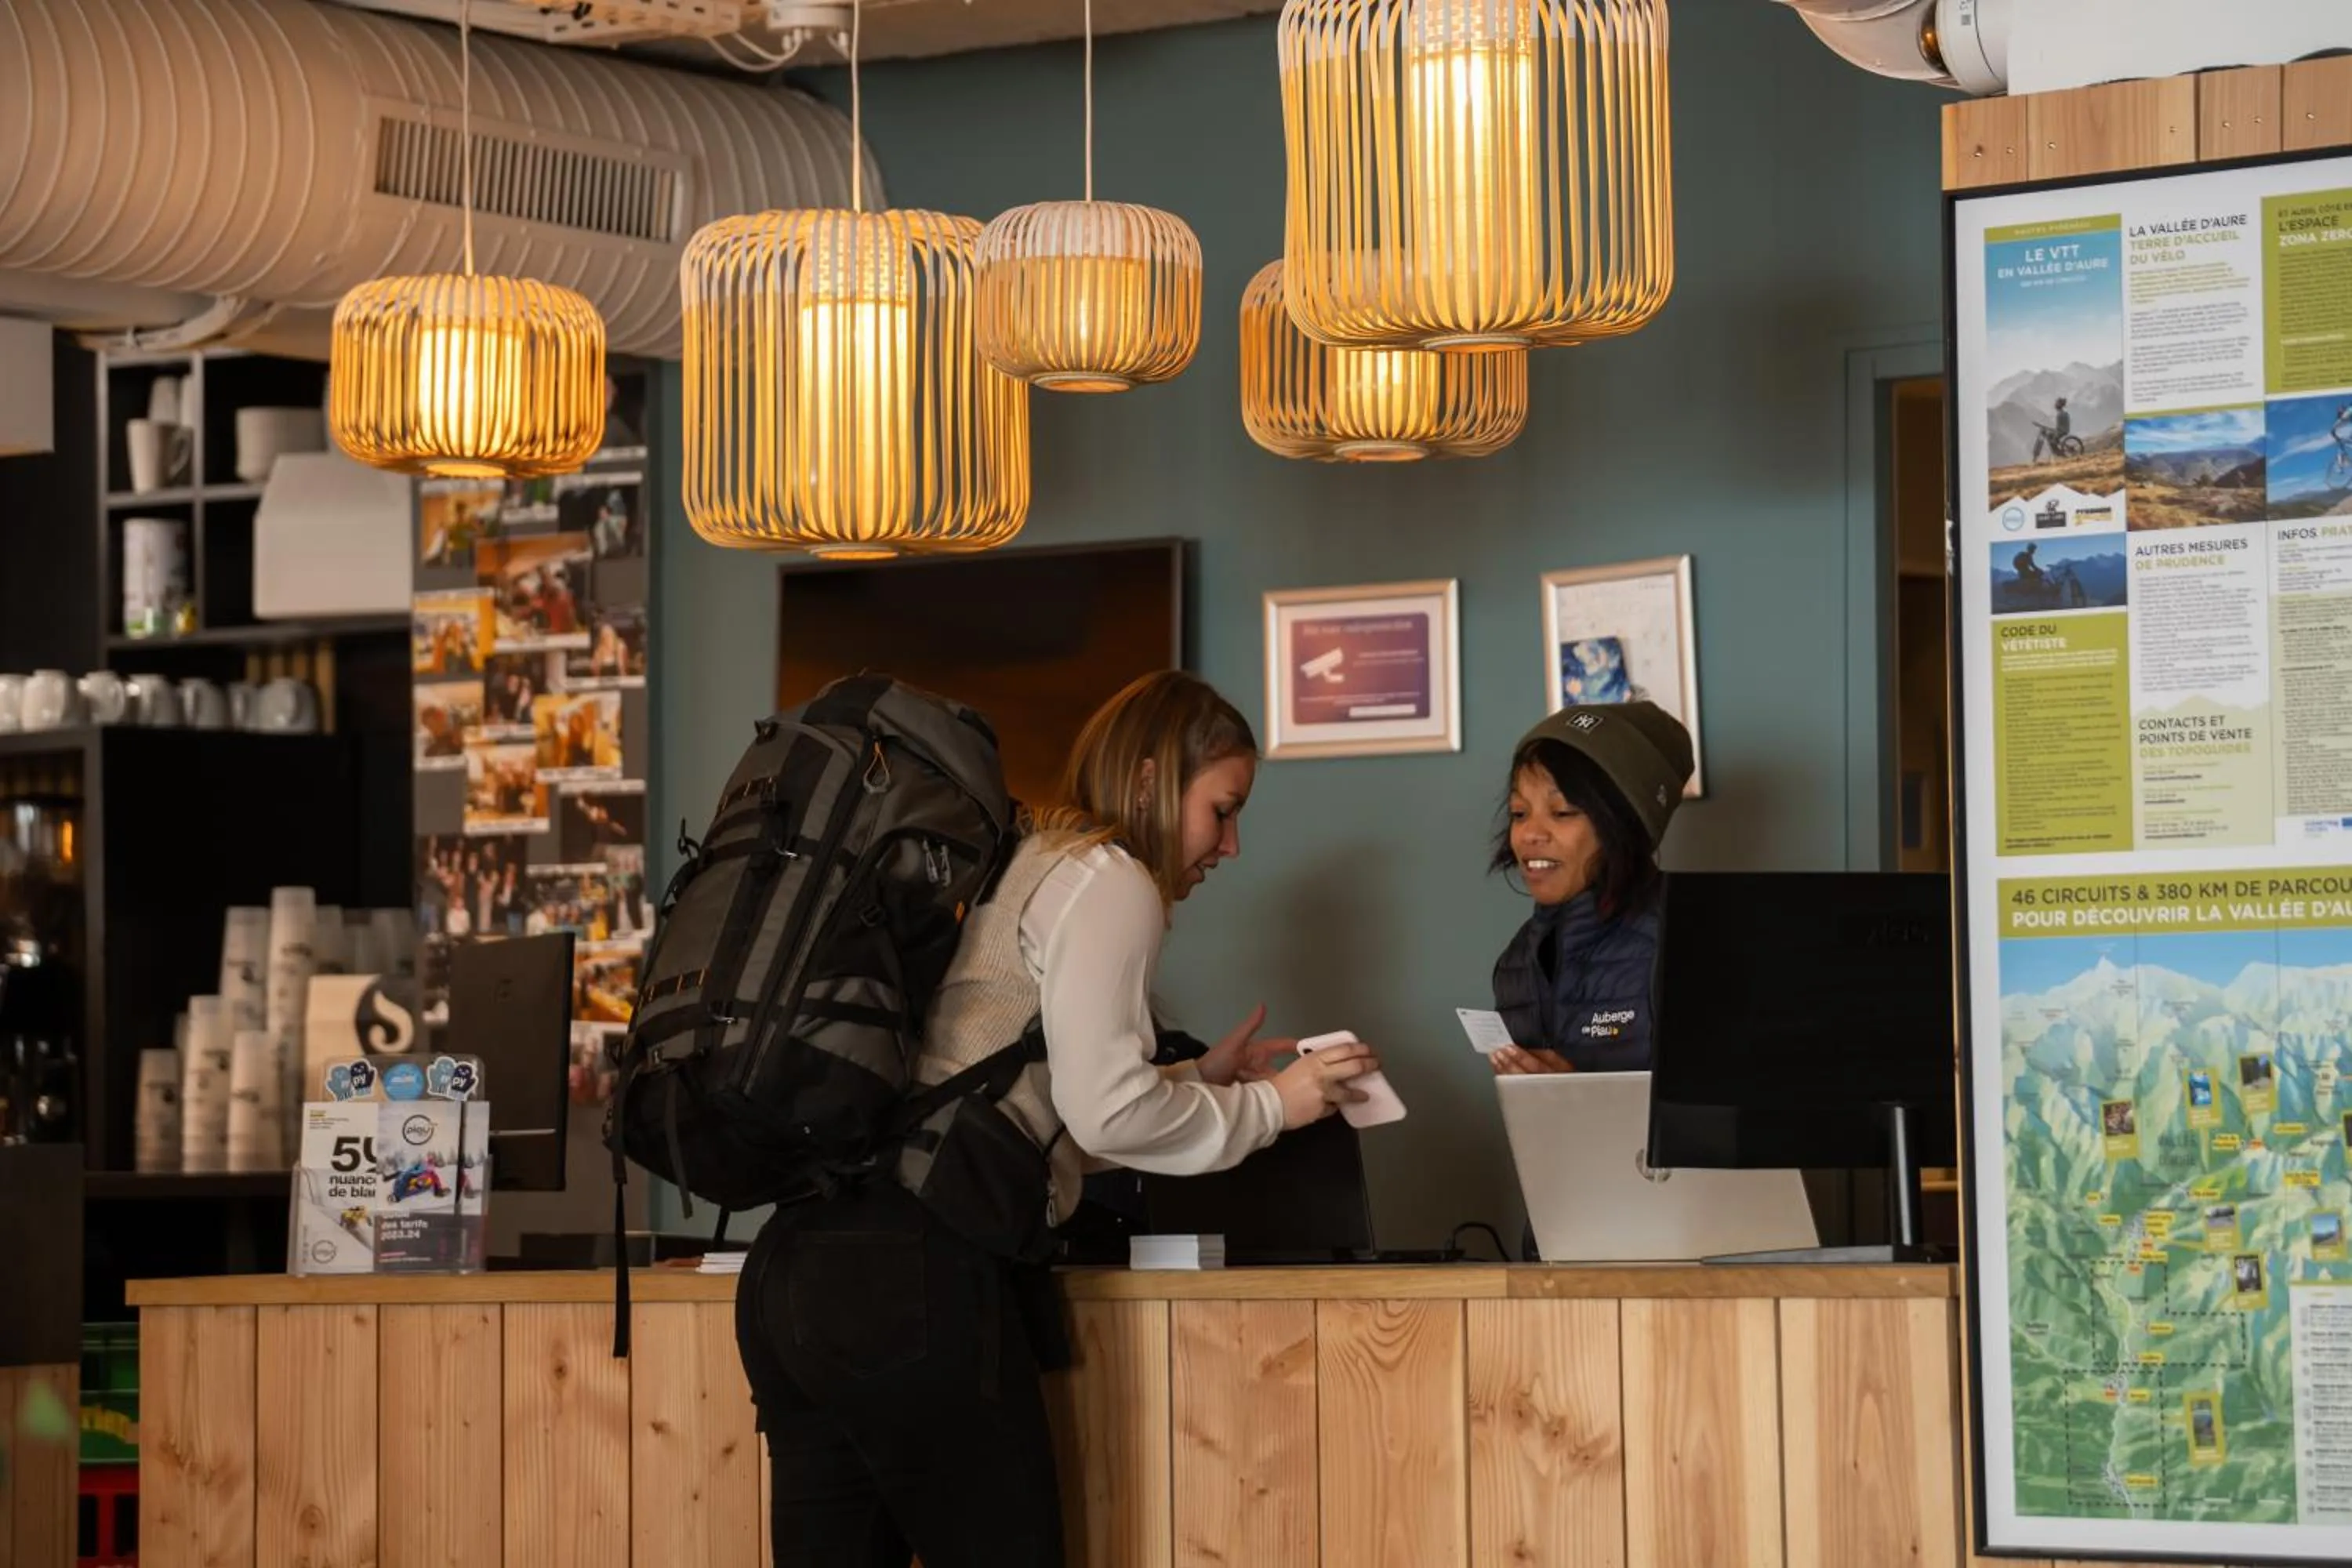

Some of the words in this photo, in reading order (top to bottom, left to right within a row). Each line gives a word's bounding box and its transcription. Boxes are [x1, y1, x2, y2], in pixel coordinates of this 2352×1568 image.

[2129, 226, 2146, 238] LA
[2150, 217, 2198, 234] VALLÉE
[2201, 214, 2247, 230] D'AURE
[2278, 215, 2339, 232] L'ESPACE
[2129, 237, 2170, 251] TERRE
[2173, 230, 2240, 246] D'ACCUEIL
[2279, 232, 2318, 247] ZONA
[2025, 248, 2045, 263] LE
[2049, 245, 2080, 260] VTT
[2130, 254, 2147, 265] DU
[2151, 249, 2186, 263] VÉLO
[1997, 267, 2013, 279] EN
[2016, 260, 2061, 276] VALLÉE
[2064, 257, 2109, 272] D'AURE
[2278, 527, 2318, 540] INFOS
[2135, 543, 2185, 556] AUTRES
[2188, 537, 2248, 552] MESURES
[2135, 559, 2152, 571] DE
[2156, 554, 2226, 568] PRUDENCE
[2001, 625, 2036, 637] CODE
[2038, 623, 2057, 635] DU
[2138, 716, 2206, 730] CONTACTS
[2209, 714, 2226, 727] ET
[2138, 731, 2185, 744] POINTS
[2188, 730, 2206, 742] DE
[2209, 728, 2253, 740] VENTE
[2140, 746, 2164, 758] DES
[2011, 889, 2035, 906] 46
[2041, 885, 2131, 904] CIRCUITS
[2136, 884, 2150, 901] &
[2156, 882, 2192, 901] 380
[2198, 881, 2228, 898] KM
[2234, 880, 2262, 897] DE
[2012, 909, 2067, 927] POUR
[2073, 904, 2190, 926] DÉCOUVRIR
[2196, 903, 2222, 922] LA
[2228, 898, 2306, 920] VALLÉE
[1592, 1010, 1635, 1024] Auberge
[329, 1175, 376, 1185] nuanc
[328, 1185, 347, 1197] de
